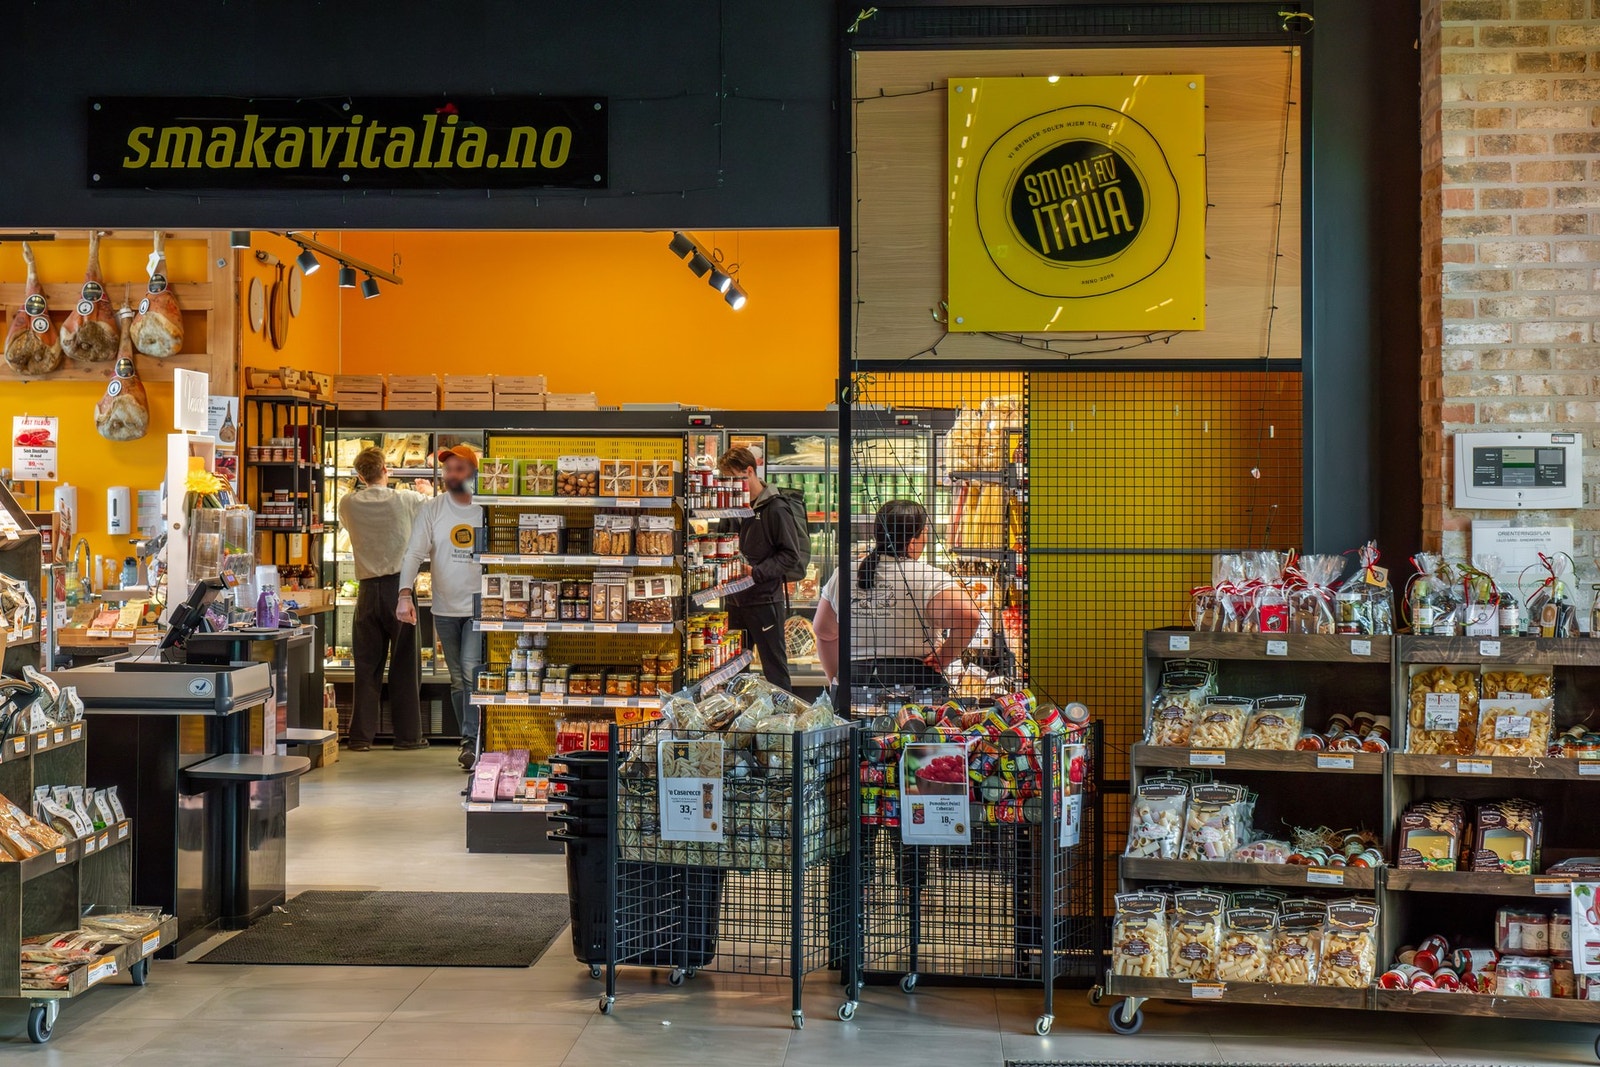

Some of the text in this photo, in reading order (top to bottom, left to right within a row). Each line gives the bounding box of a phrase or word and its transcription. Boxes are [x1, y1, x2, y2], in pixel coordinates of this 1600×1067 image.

[122, 114, 572, 169] smakavitalia.no
[1015, 131, 1041, 152] BRINGER
[1042, 123, 1064, 134] SOLEN
[1023, 158, 1096, 207] SMAK
[1031, 186, 1135, 255] ITALIA
[679, 804, 697, 816] 33,-
[941, 815, 955, 825] 18,-
